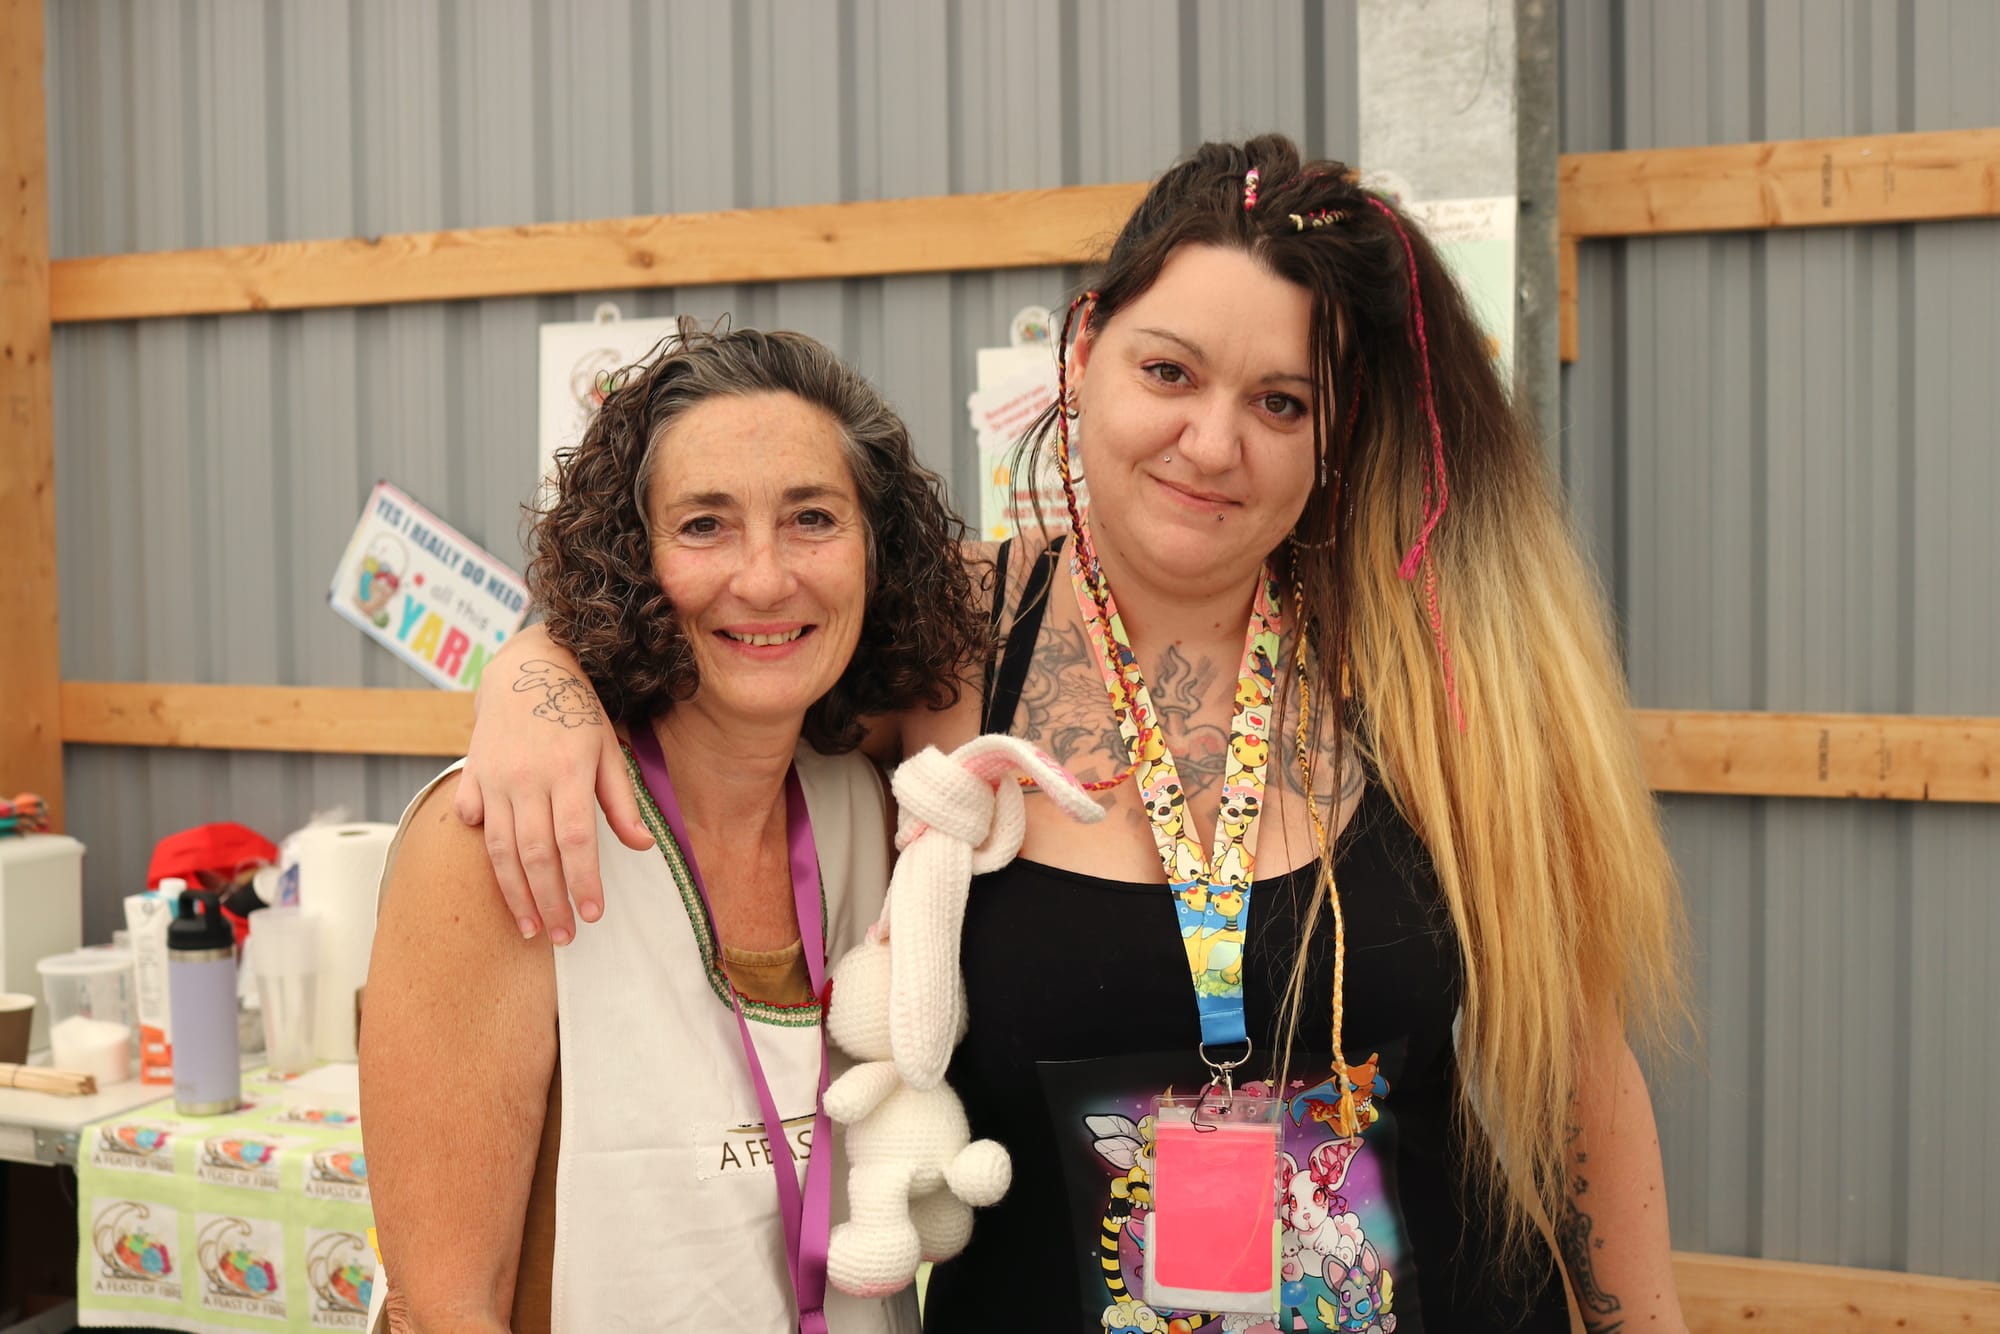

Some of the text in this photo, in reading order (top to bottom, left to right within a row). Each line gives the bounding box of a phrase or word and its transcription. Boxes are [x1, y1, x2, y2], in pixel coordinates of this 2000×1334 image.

[377, 497, 524, 613] YES I REALLY DO NEED
[396, 594, 494, 691] YARN
[430, 585, 490, 631] all this
[720, 1130, 812, 1170] A FES
